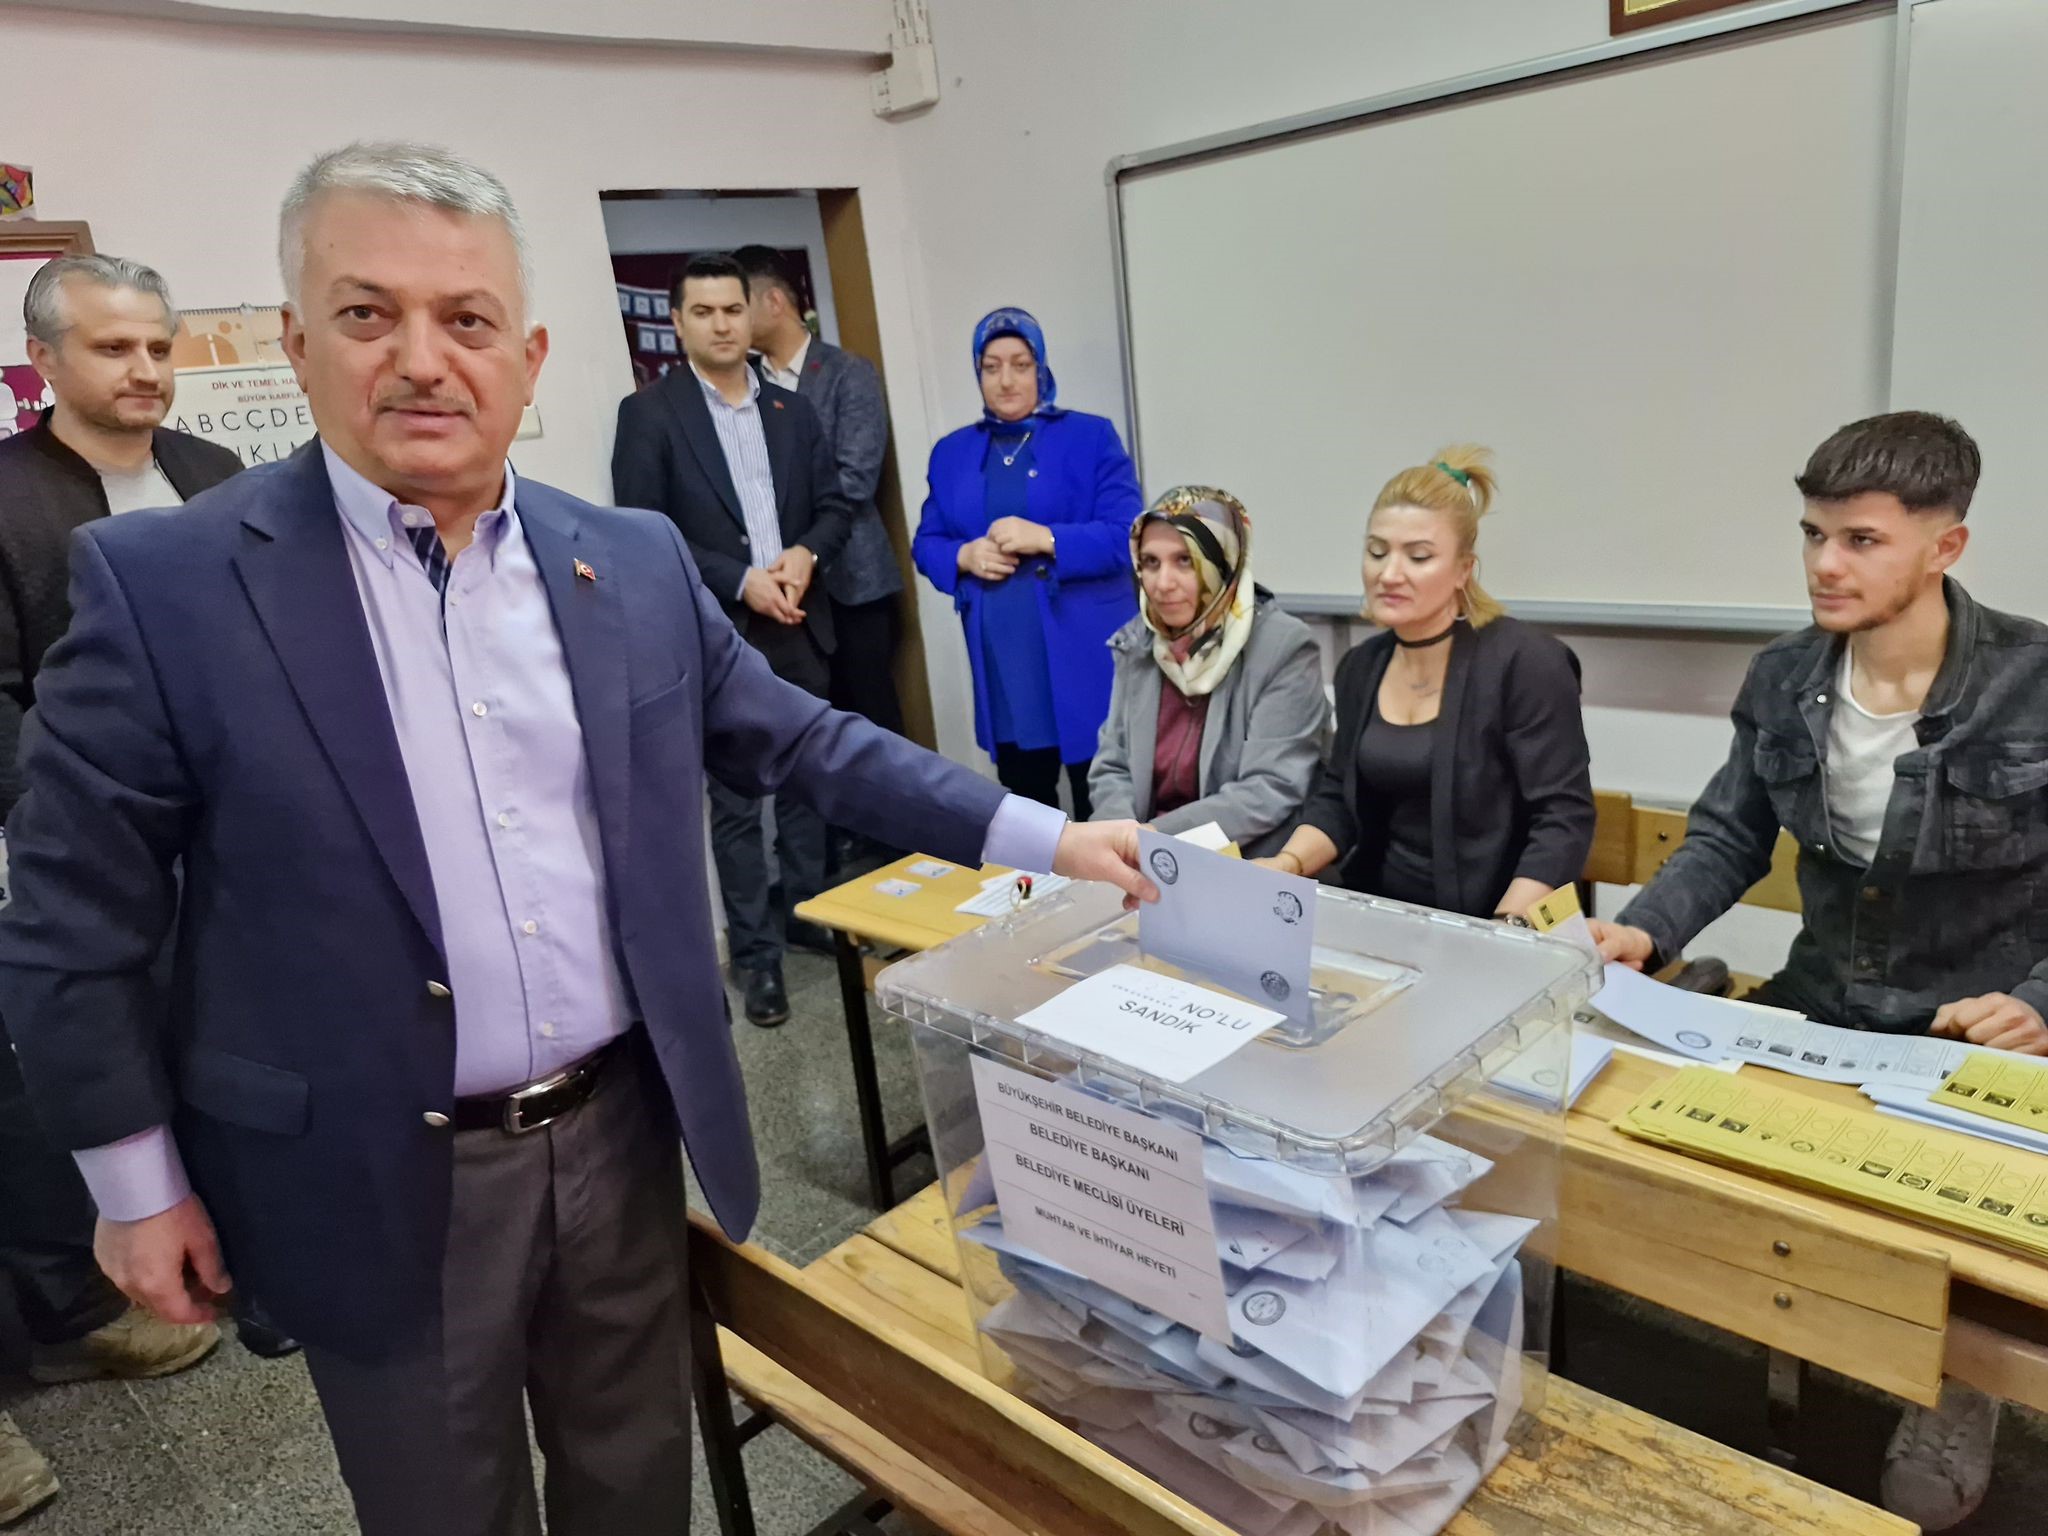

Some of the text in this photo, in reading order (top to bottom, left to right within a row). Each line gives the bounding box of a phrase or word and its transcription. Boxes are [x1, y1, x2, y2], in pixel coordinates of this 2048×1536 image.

[232, 380, 245, 389] VE
[248, 378, 279, 388] TEMEL
[1119, 1000, 1203, 1034] SANDIK
[1180, 1002, 1252, 1030] NO'LU
[998, 1082, 1179, 1162] BÜYÜKŞEHİR BELEDİYE BAŞKANI
[1030, 1123, 1150, 1181] BELEDİYE BAŞKANI
[1016, 1153, 1185, 1236] BELEDİYE MECLİSİ ÜYELERİ
[1035, 1205, 1076, 1232] MUHTAR
[1078, 1225, 1092, 1239] VE
[1137, 1252, 1177, 1279] HEYETİ
